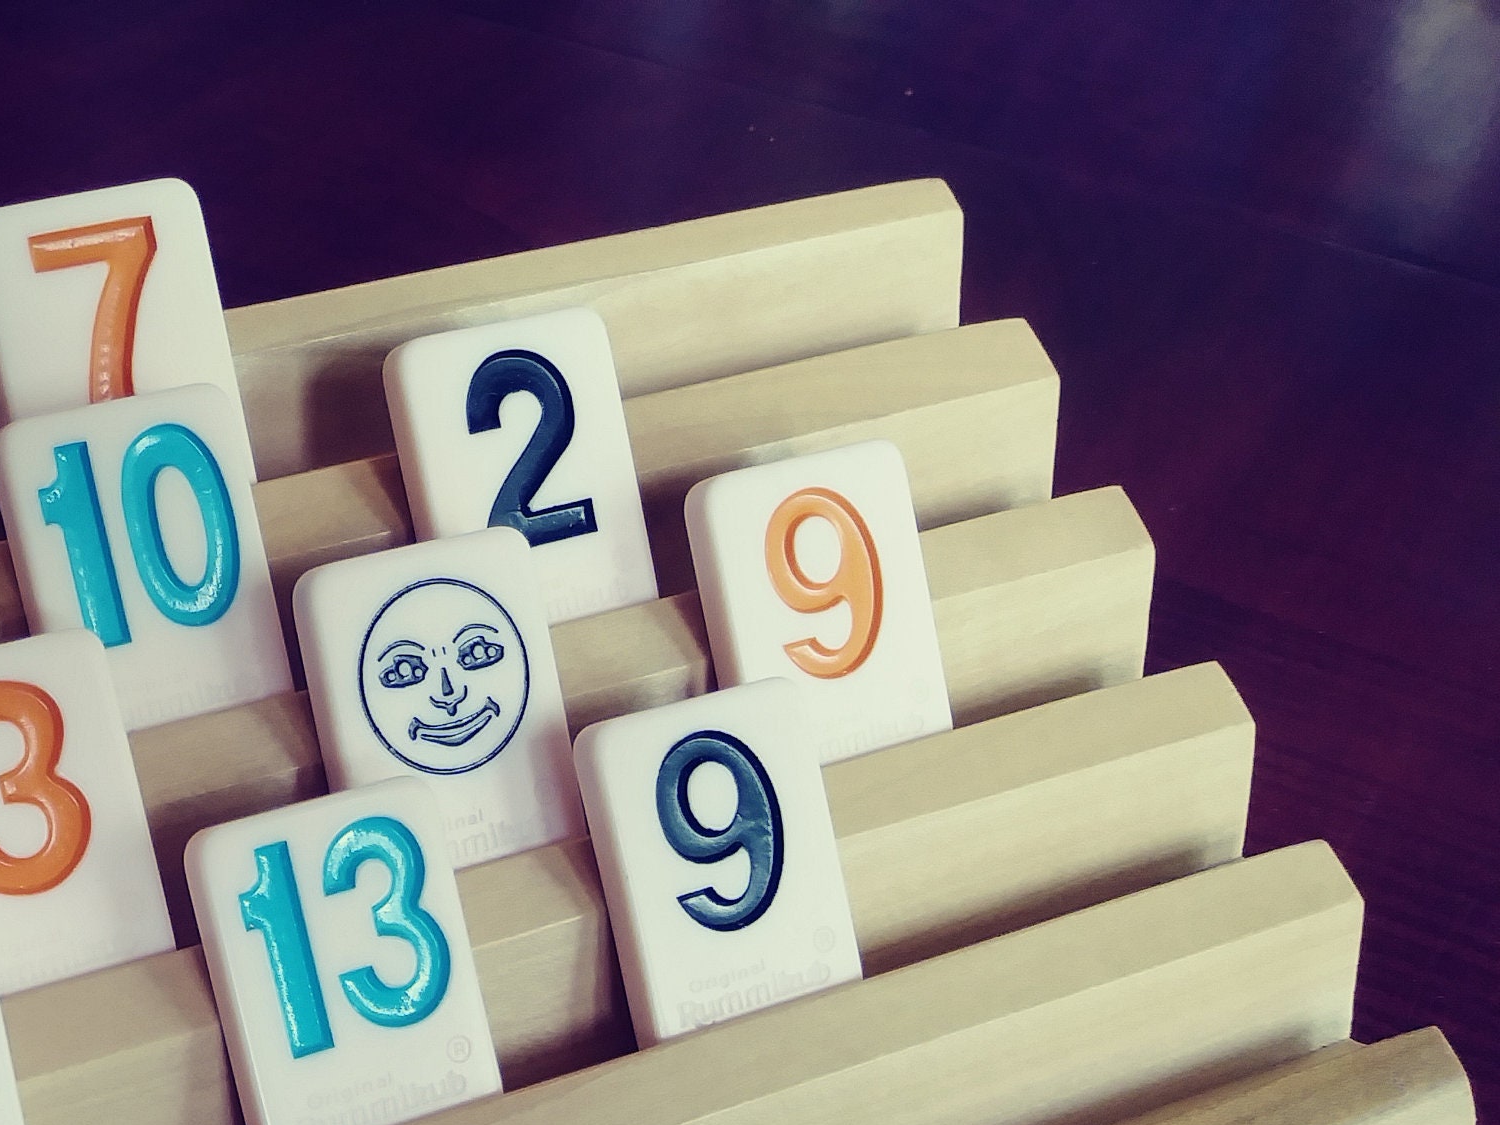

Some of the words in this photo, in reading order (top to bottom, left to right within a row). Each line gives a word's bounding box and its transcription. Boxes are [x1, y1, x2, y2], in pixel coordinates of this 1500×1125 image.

[29, 216, 157, 403] 7
[38, 423, 240, 648] 10
[466, 350, 598, 547] 2
[767, 488, 883, 678] 9
[656, 730, 784, 932] 9
[238, 816, 451, 1059] 13
